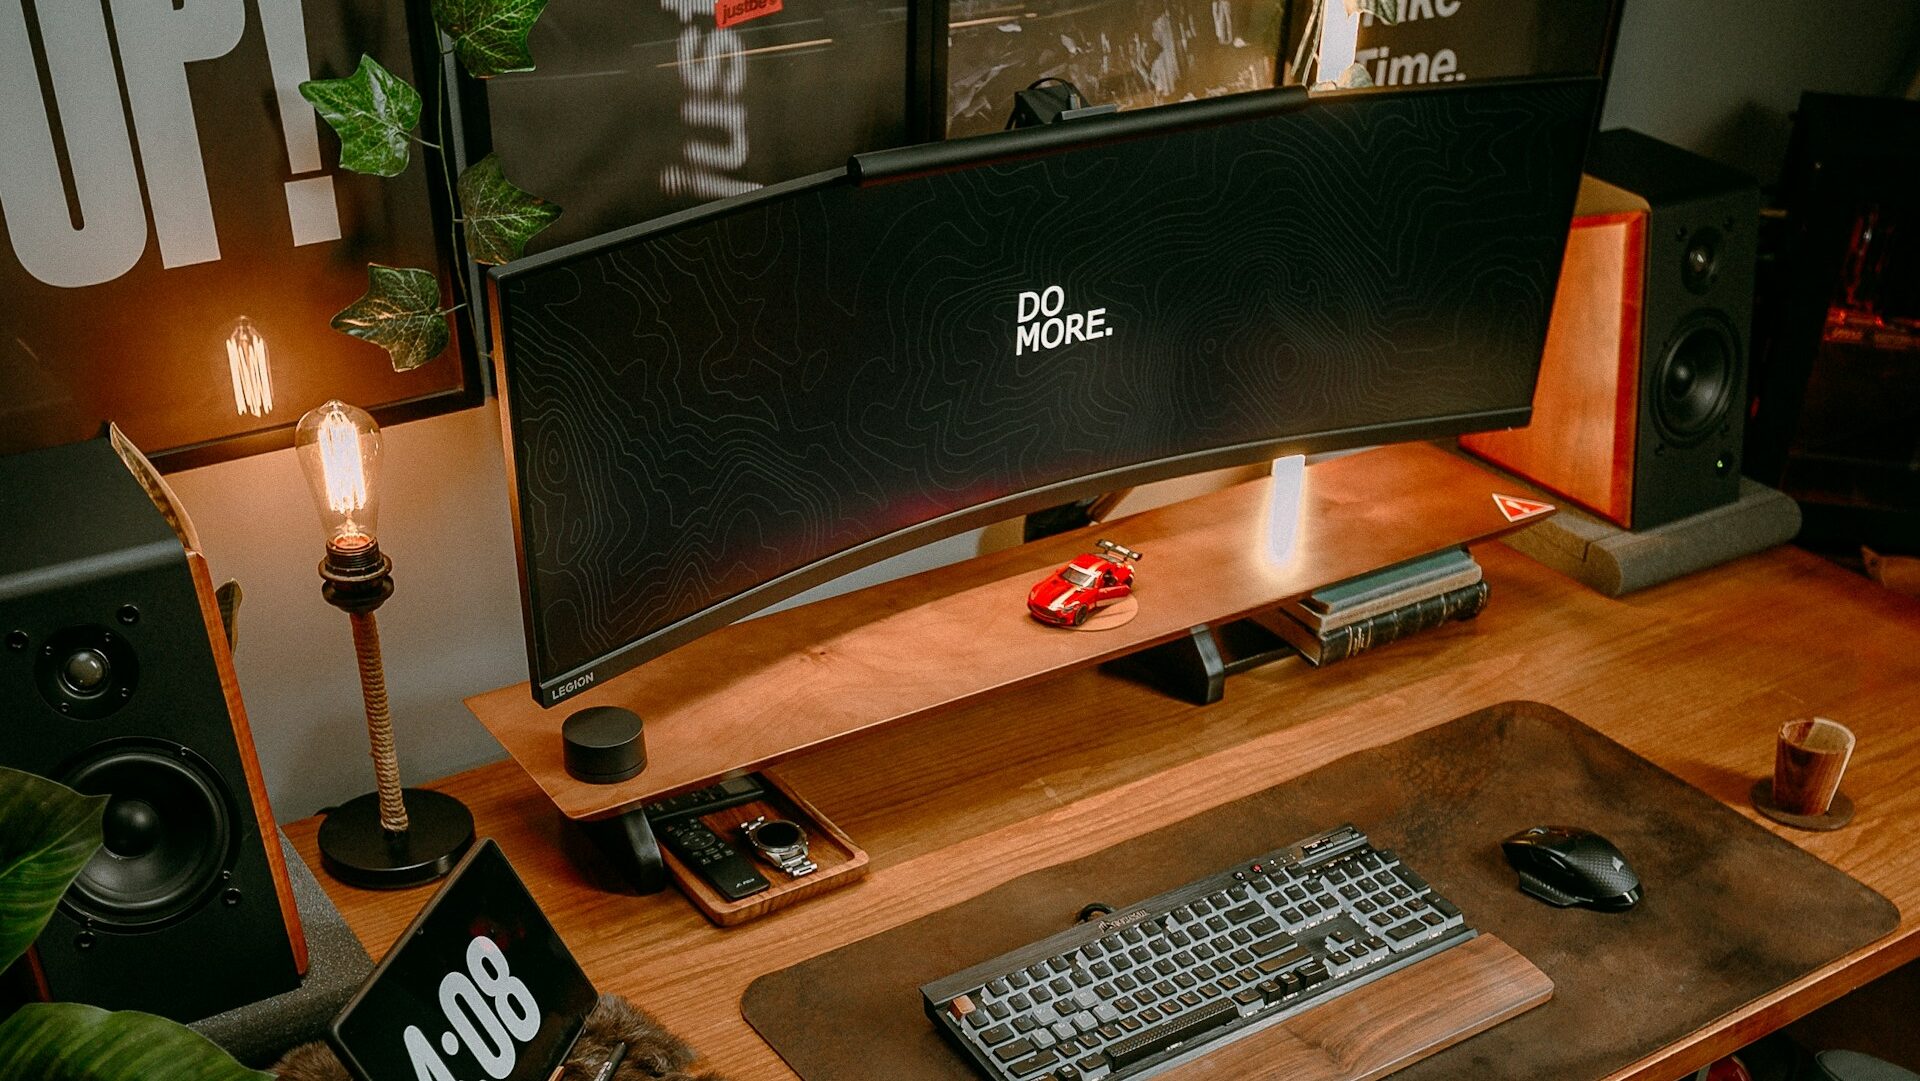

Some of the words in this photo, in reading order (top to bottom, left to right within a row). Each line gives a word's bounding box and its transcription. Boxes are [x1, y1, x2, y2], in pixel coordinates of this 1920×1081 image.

[1362, 0, 1461, 27] ke
[0, 0, 342, 288] UP!
[1018, 285, 1065, 323] DO
[1016, 308, 1113, 356] MORE.
[552, 671, 594, 700] LEGION
